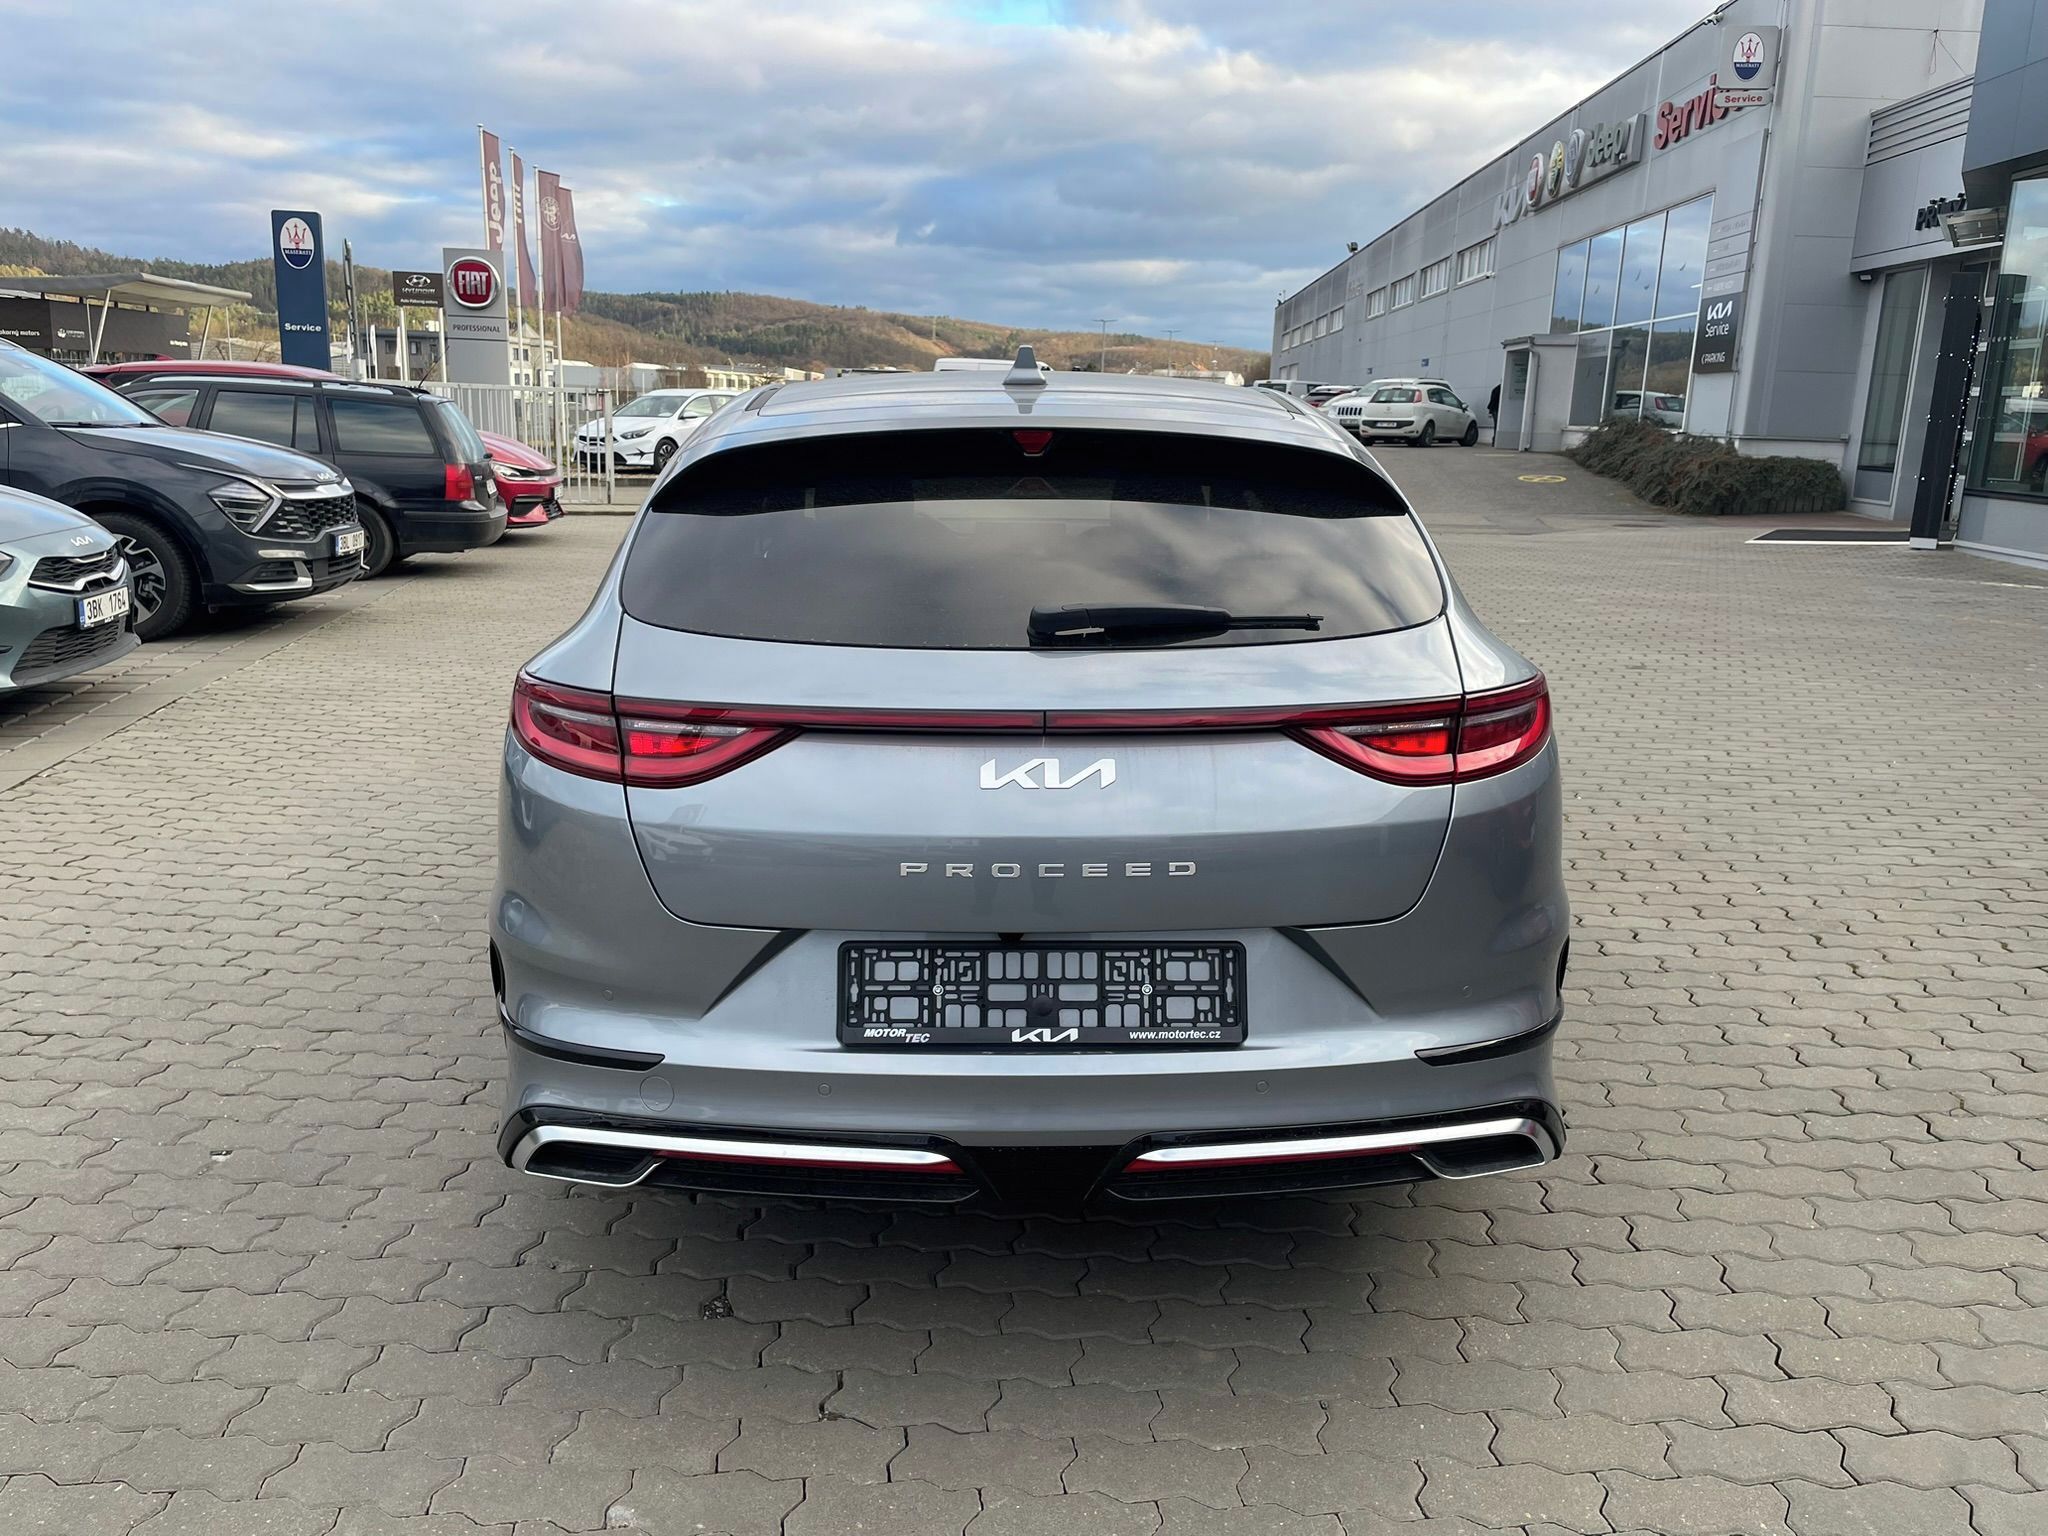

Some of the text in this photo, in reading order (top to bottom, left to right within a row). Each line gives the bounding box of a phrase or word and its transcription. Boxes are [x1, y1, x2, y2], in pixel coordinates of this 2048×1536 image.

[1724, 95, 1763, 104] Service
[1654, 74, 1746, 149] Servi
[488, 161, 503, 243] Jeep
[457, 270, 489, 295] FIAT
[1707, 301, 1733, 320] KIA
[284, 322, 322, 332] Service
[453, 324, 501, 333] PROFESSIONAL
[1705, 323, 1730, 337] Service
[70, 535, 94, 547] KIA
[86, 590, 126, 620] 3BK 1764
[980, 758, 1116, 789] KIA
[900, 862, 1196, 878] PROCEED
[864, 1028, 931, 1043] MOTOR TEC
[1011, 1028, 1079, 1042] KIA
[1129, 1030, 1221, 1041] www.motortec.cz
